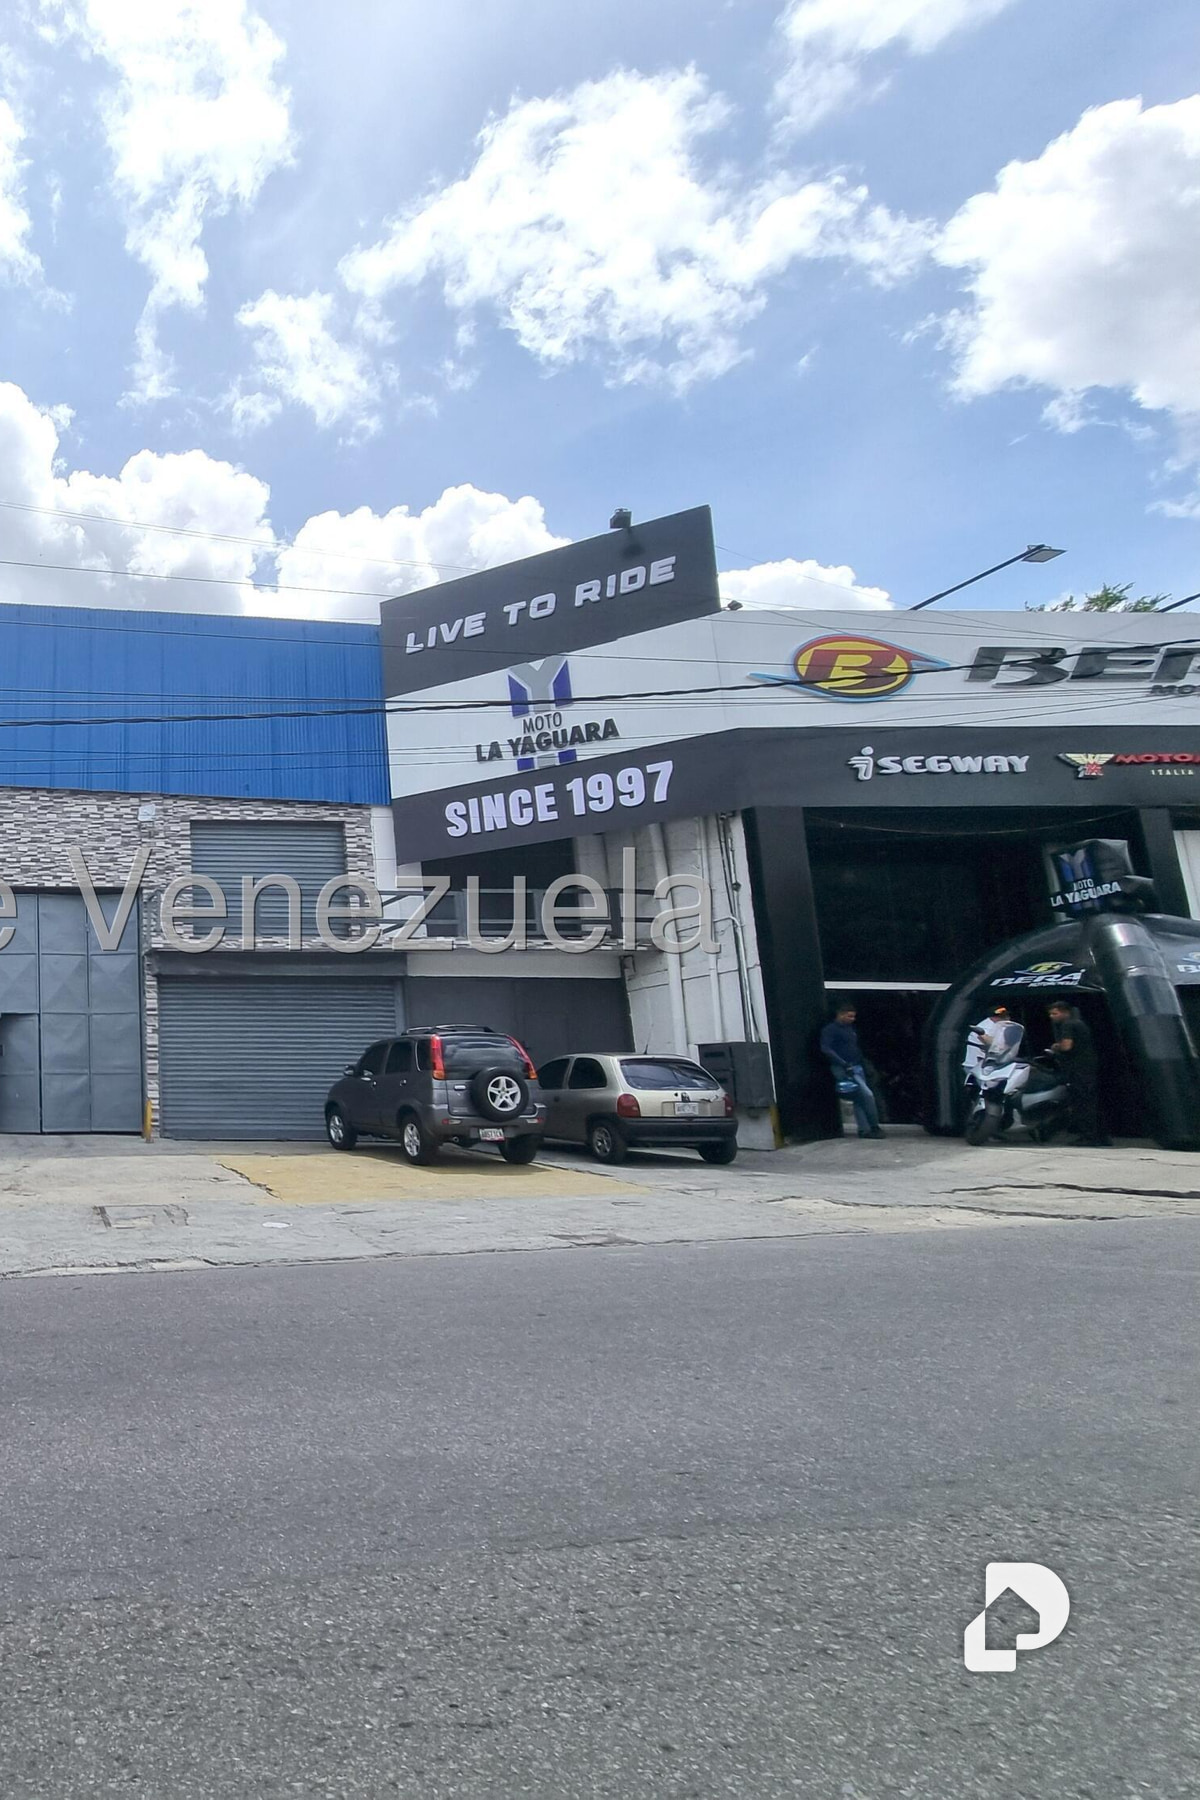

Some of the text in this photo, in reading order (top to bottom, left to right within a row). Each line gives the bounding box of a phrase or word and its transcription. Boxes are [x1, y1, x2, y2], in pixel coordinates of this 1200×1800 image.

[405, 555, 677, 655] LIVE TO RIDE
[522, 711, 563, 735] MOTO
[476, 718, 620, 763] LA YAGUARA
[876, 755, 1030, 775] SEGWAY
[444, 760, 674, 838] SINCE 1997
[1050, 881, 1122, 907] LA YAGUARA
[990, 972, 1082, 986] BERA
